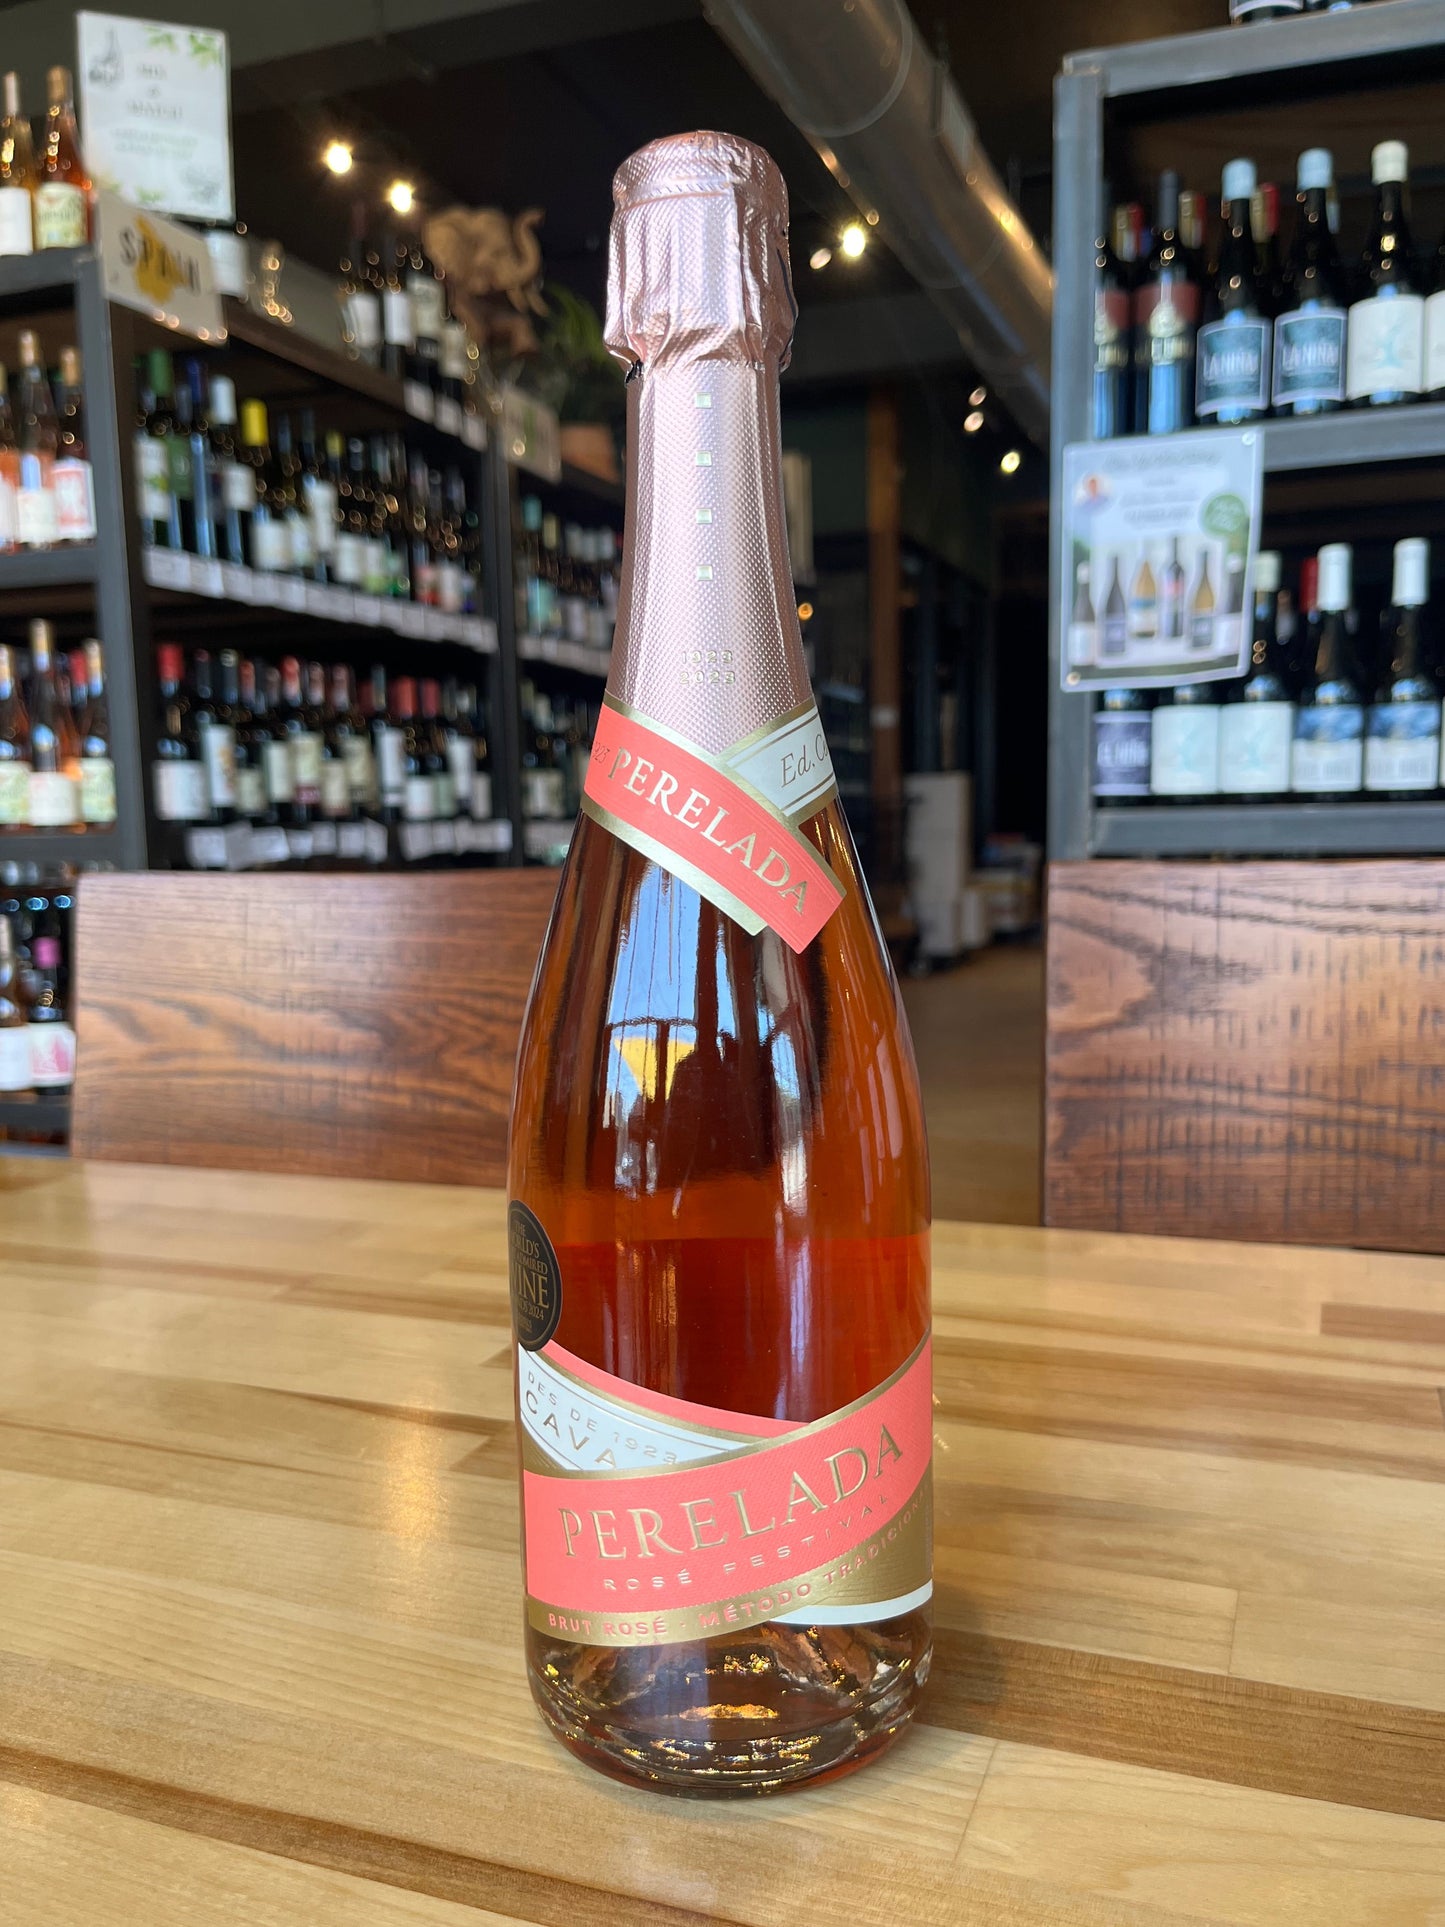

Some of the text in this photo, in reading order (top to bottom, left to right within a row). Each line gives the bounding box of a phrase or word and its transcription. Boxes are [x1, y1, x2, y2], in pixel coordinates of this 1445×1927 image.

[680, 670, 735, 685] 2023
[681, 650, 733, 664] 1923
[781, 744, 816, 788] Ed.
[607, 746, 810, 916] PERELADA
[525, 1389, 617, 1468] CAVA
[613, 1431, 678, 1465] 1923
[558, 1424, 904, 1560] PERELADA
[603, 1495, 888, 1591] ROSÉ FESTIVAL
[548, 1612, 592, 1636] BRUT
[602, 1616, 667, 1637] ROSÉ
[698, 1583, 812, 1628] MÉTODO
